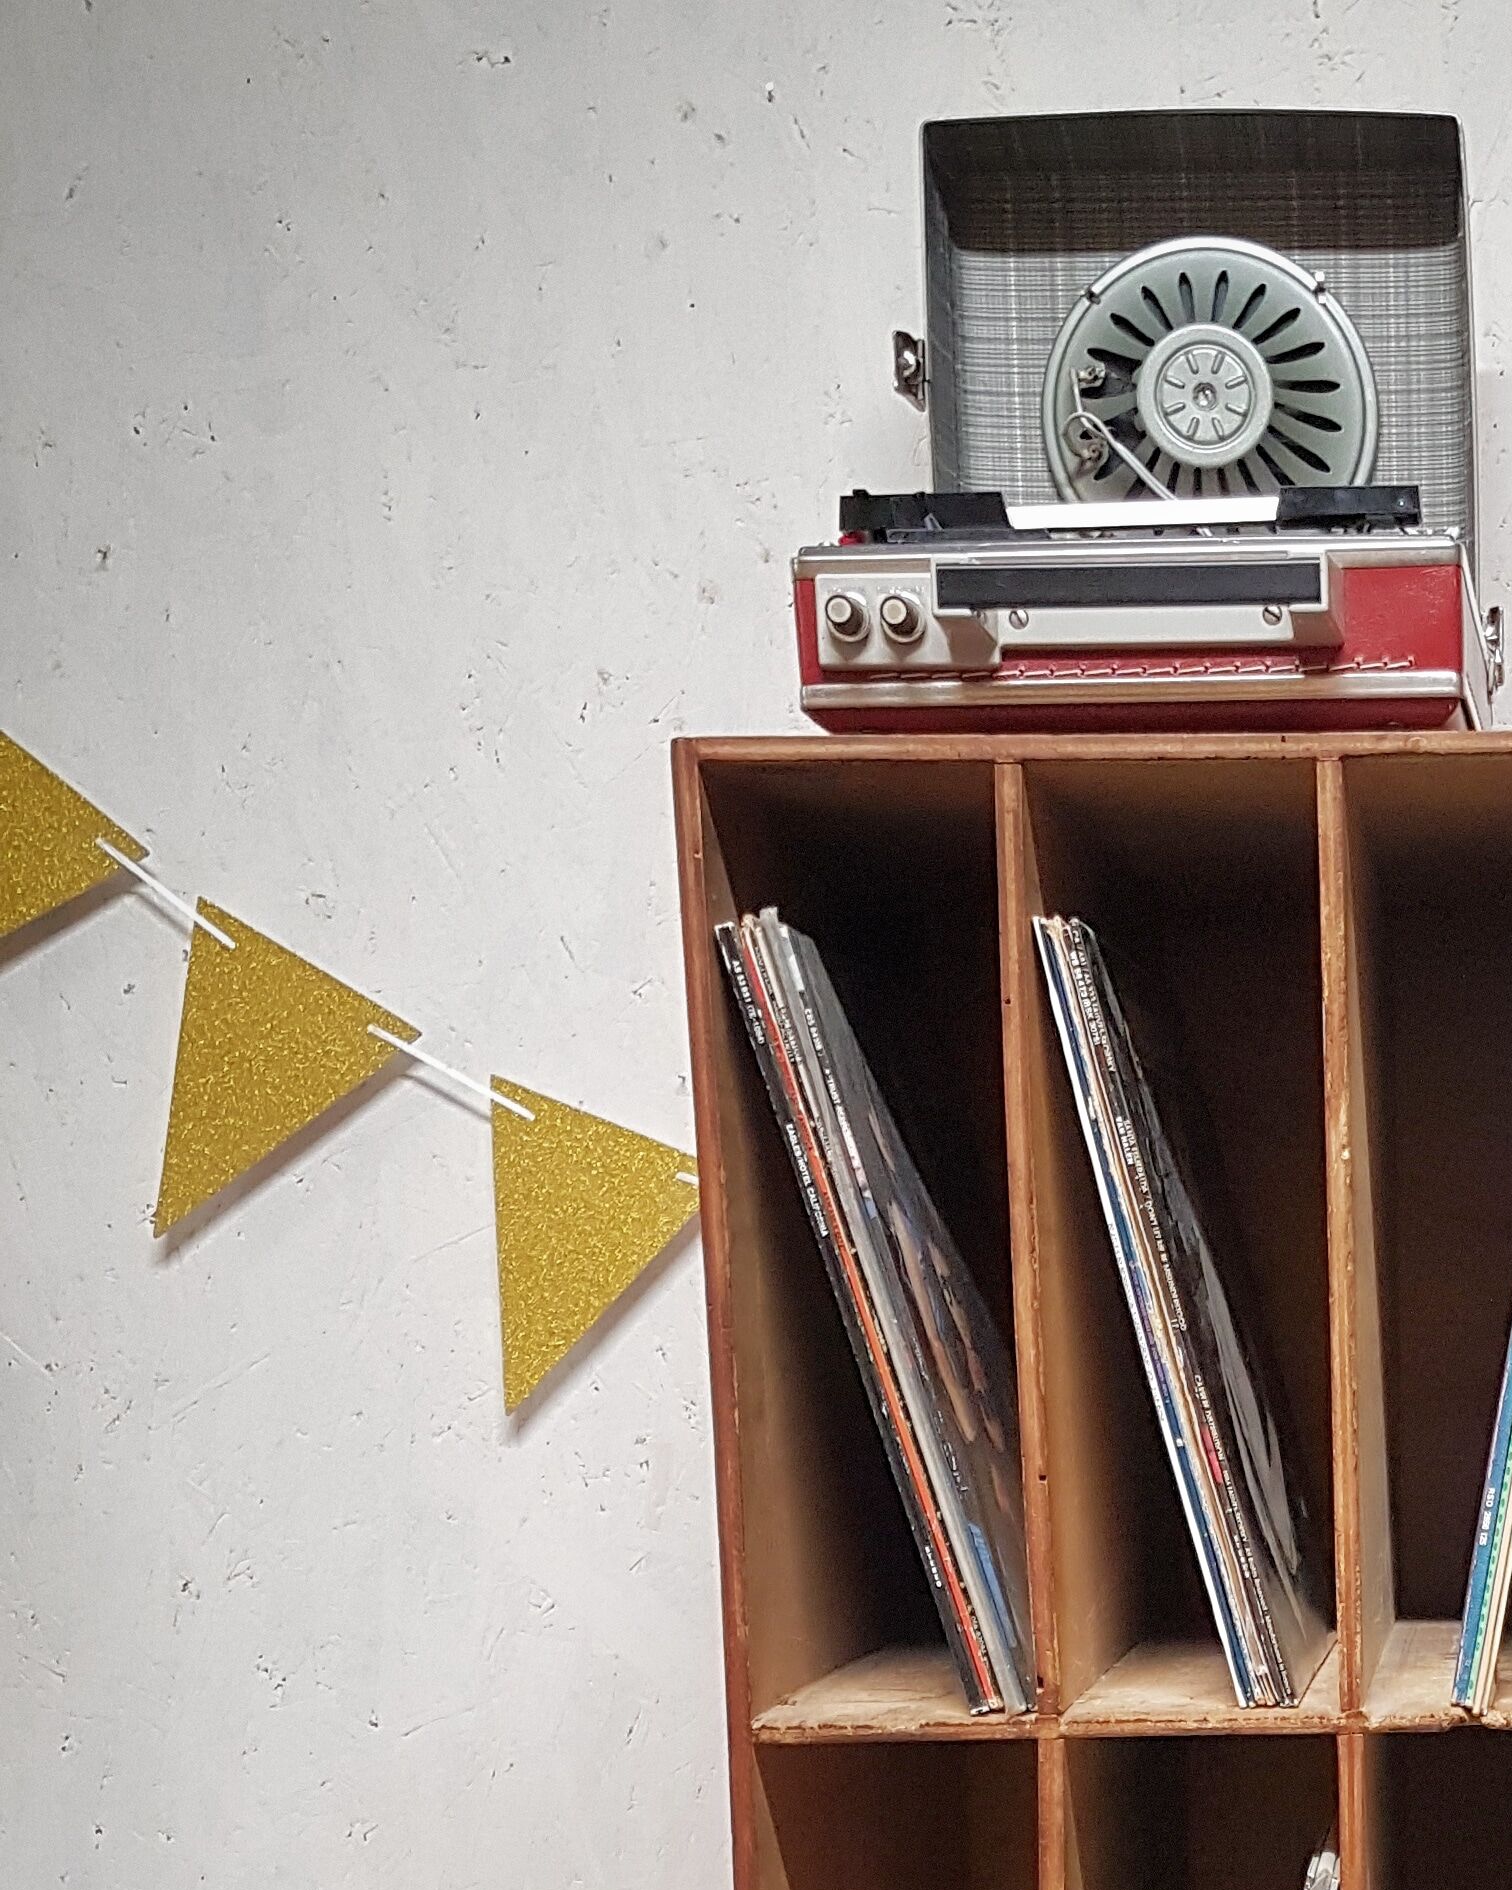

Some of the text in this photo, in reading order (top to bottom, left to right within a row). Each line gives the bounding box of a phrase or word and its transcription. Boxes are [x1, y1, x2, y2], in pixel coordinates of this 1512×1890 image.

[1114, 1116, 1125, 1134] VAN
[1119, 1135, 1134, 1165] HALEN
[805, 1186, 828, 1238] CALIFORNIA
[1485, 1487, 1495, 1507] RSO
